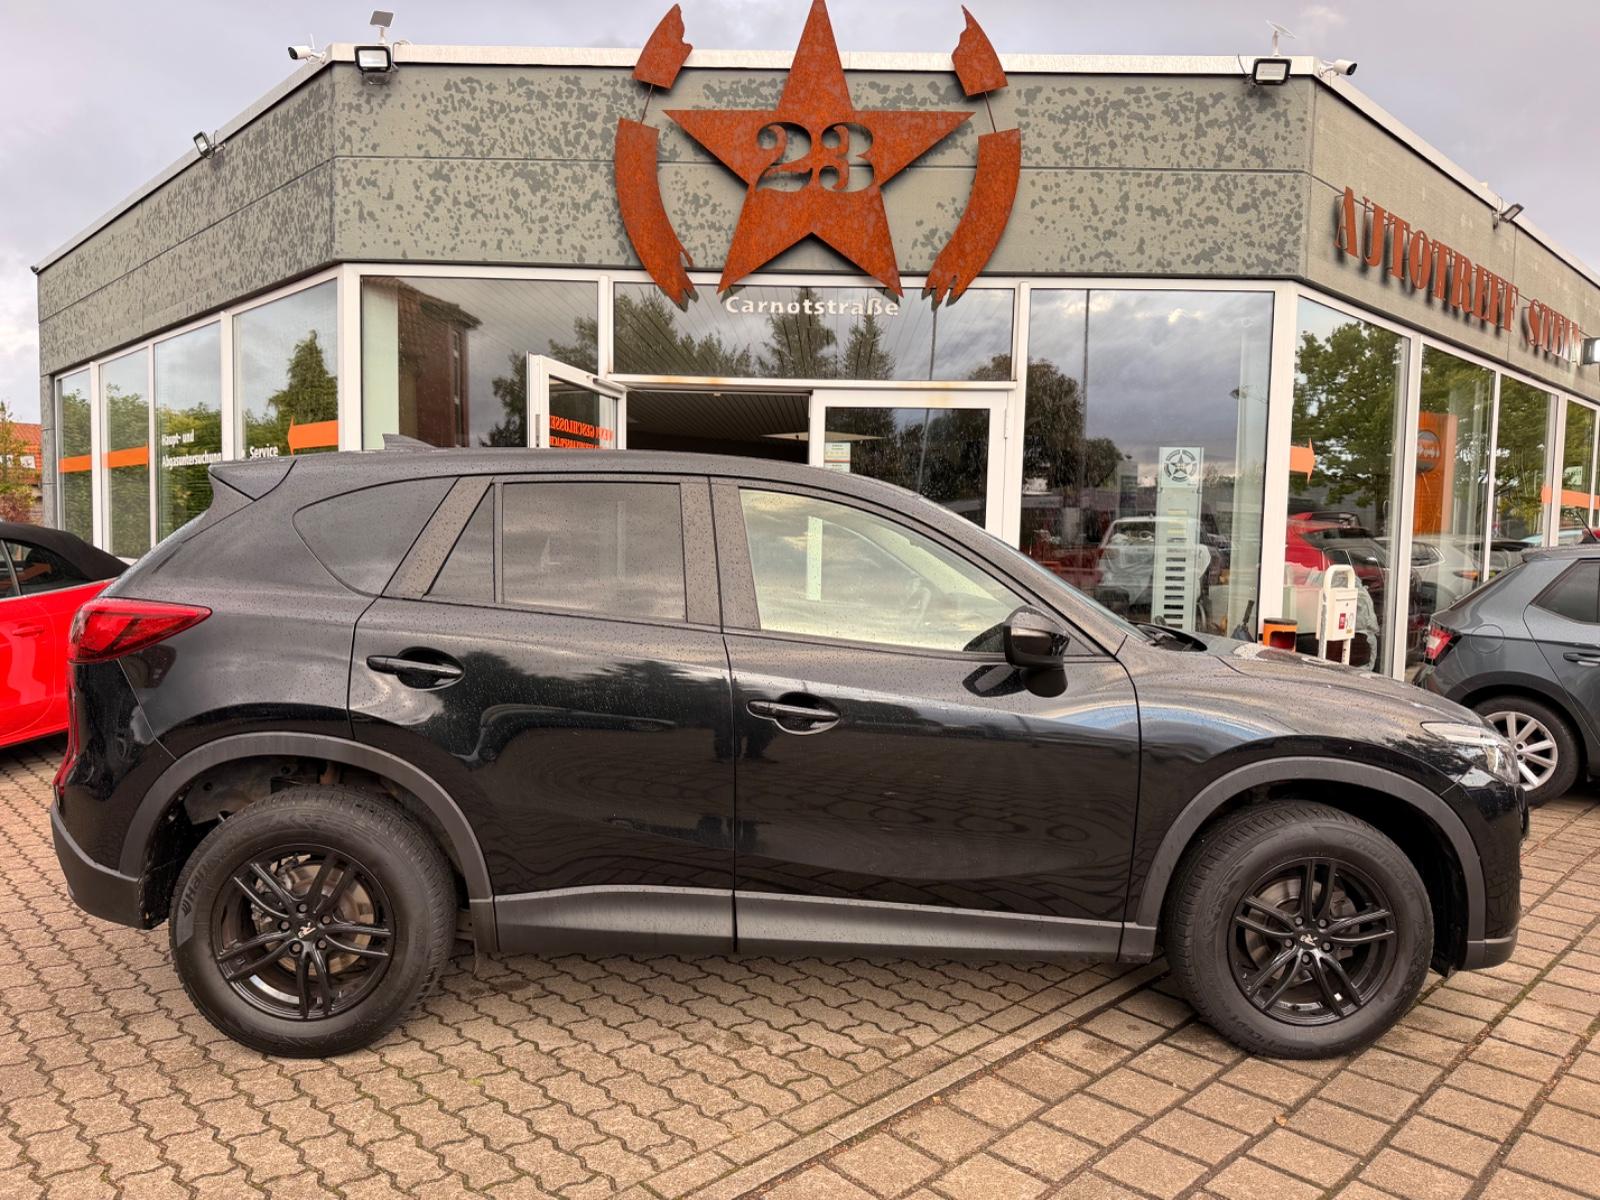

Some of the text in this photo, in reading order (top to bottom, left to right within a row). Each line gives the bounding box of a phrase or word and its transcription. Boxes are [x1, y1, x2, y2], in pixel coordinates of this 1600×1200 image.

[756, 121, 874, 193] 23
[1334, 186, 1518, 332] AUTOTREFF
[725, 296, 899, 316] Carnotstraße
[182, 429, 194, 442] und
[250, 444, 278, 459] Service
